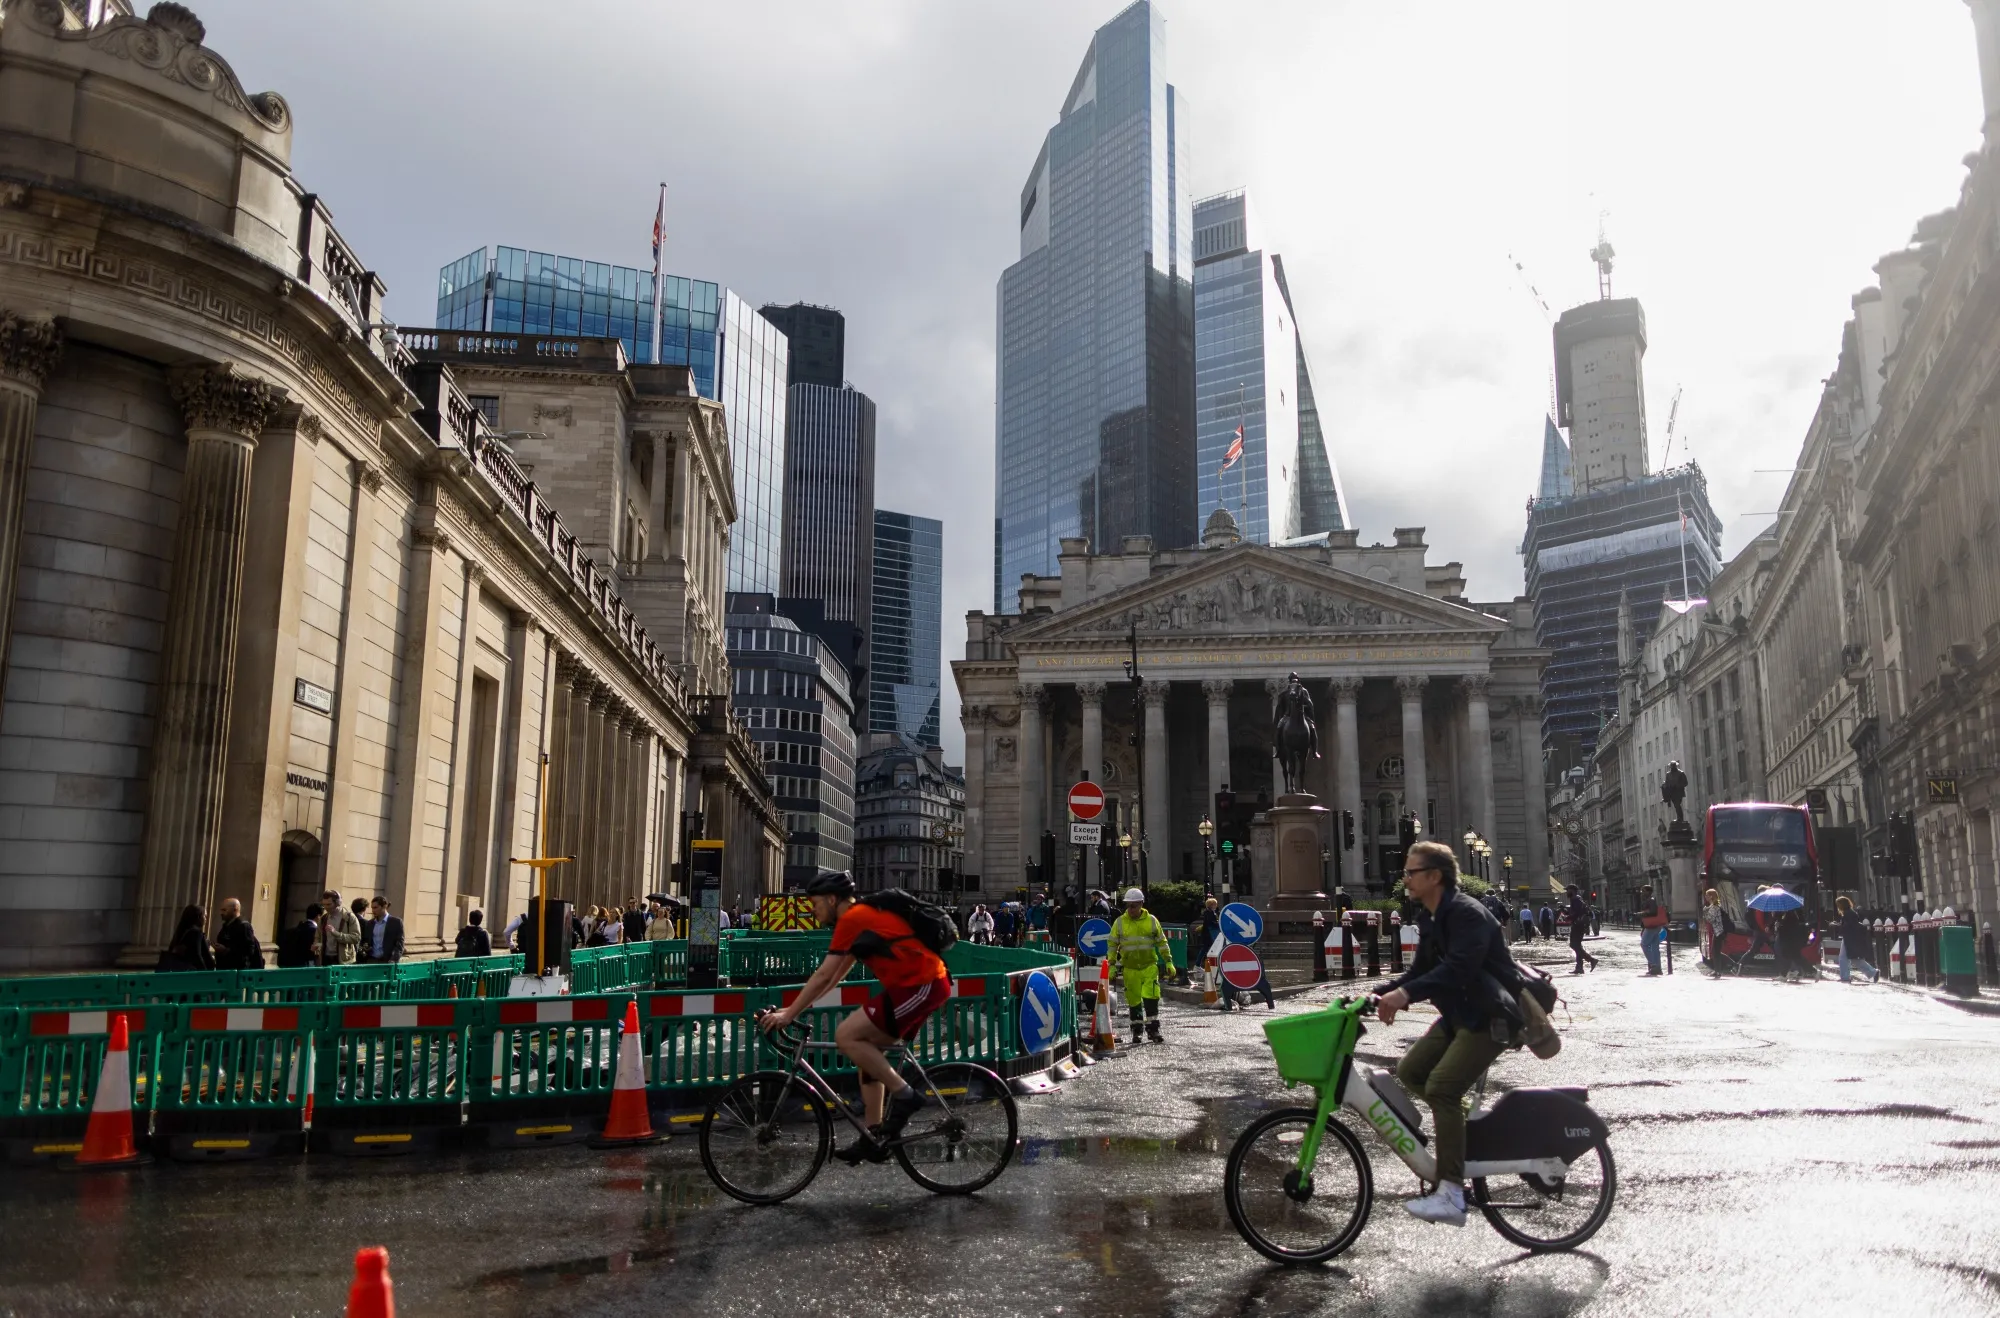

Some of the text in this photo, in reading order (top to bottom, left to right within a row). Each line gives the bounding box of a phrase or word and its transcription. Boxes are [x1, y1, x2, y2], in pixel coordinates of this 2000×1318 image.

[1073, 655, 1144, 666] ELIZABETE
[286, 772, 328, 792] NDERGROUND
[1074, 825, 1099, 834] Except
[1074, 834, 1097, 842] cycles
[1724, 854, 1736, 864] City
[1781, 855, 1797, 867] 25
[1368, 1099, 1416, 1155] Lime
[1564, 1126, 1590, 1138] Lime
